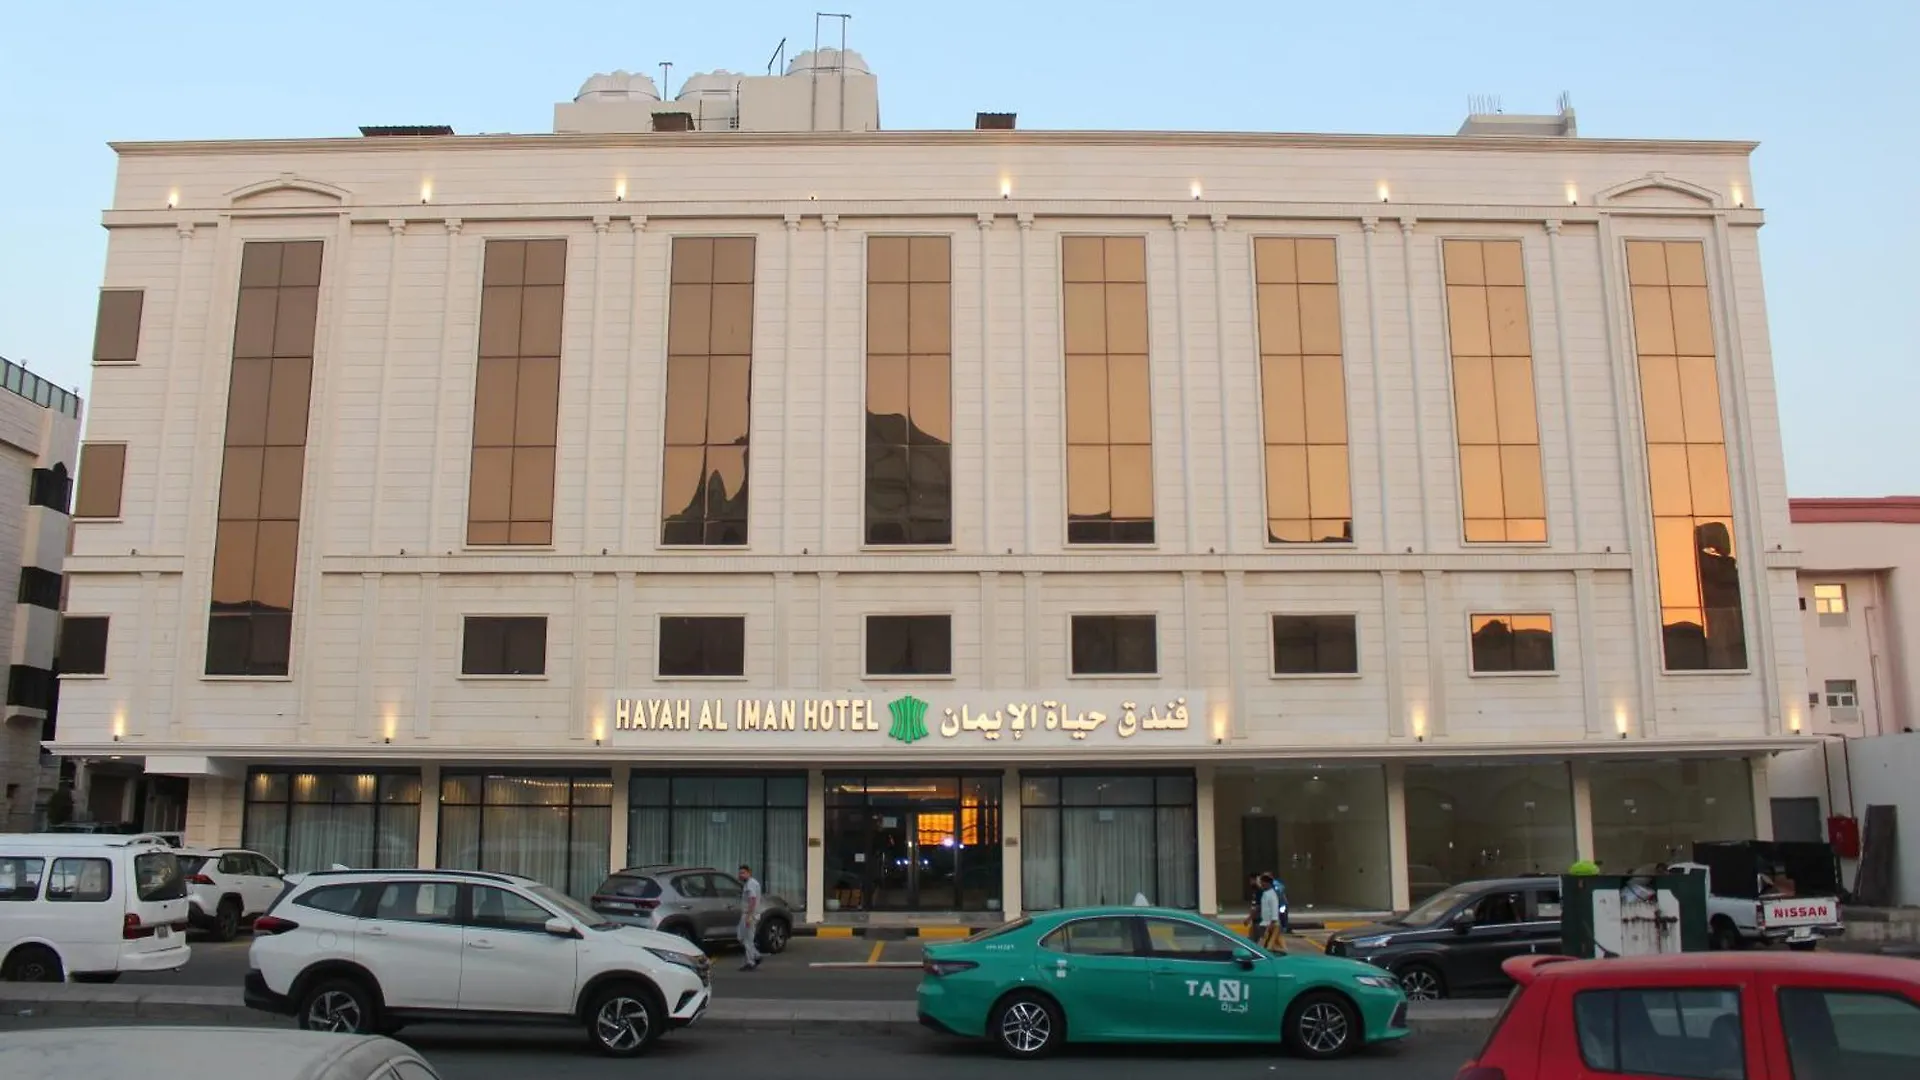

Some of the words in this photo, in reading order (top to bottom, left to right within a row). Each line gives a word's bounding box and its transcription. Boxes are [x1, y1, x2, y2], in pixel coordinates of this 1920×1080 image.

[615, 699, 691, 731] HAYAH
[698, 699, 729, 731] AL
[736, 699, 796, 731] IMAN
[804, 699, 880, 731] HOTEL
[940, 701, 1037, 741] الإيمان
[1042, 700, 1107, 740] حياة
[1117, 697, 1190, 738] فندق
[1774, 904, 1828, 918] NISSAN
[1184, 979, 1250, 1002] TAXI
